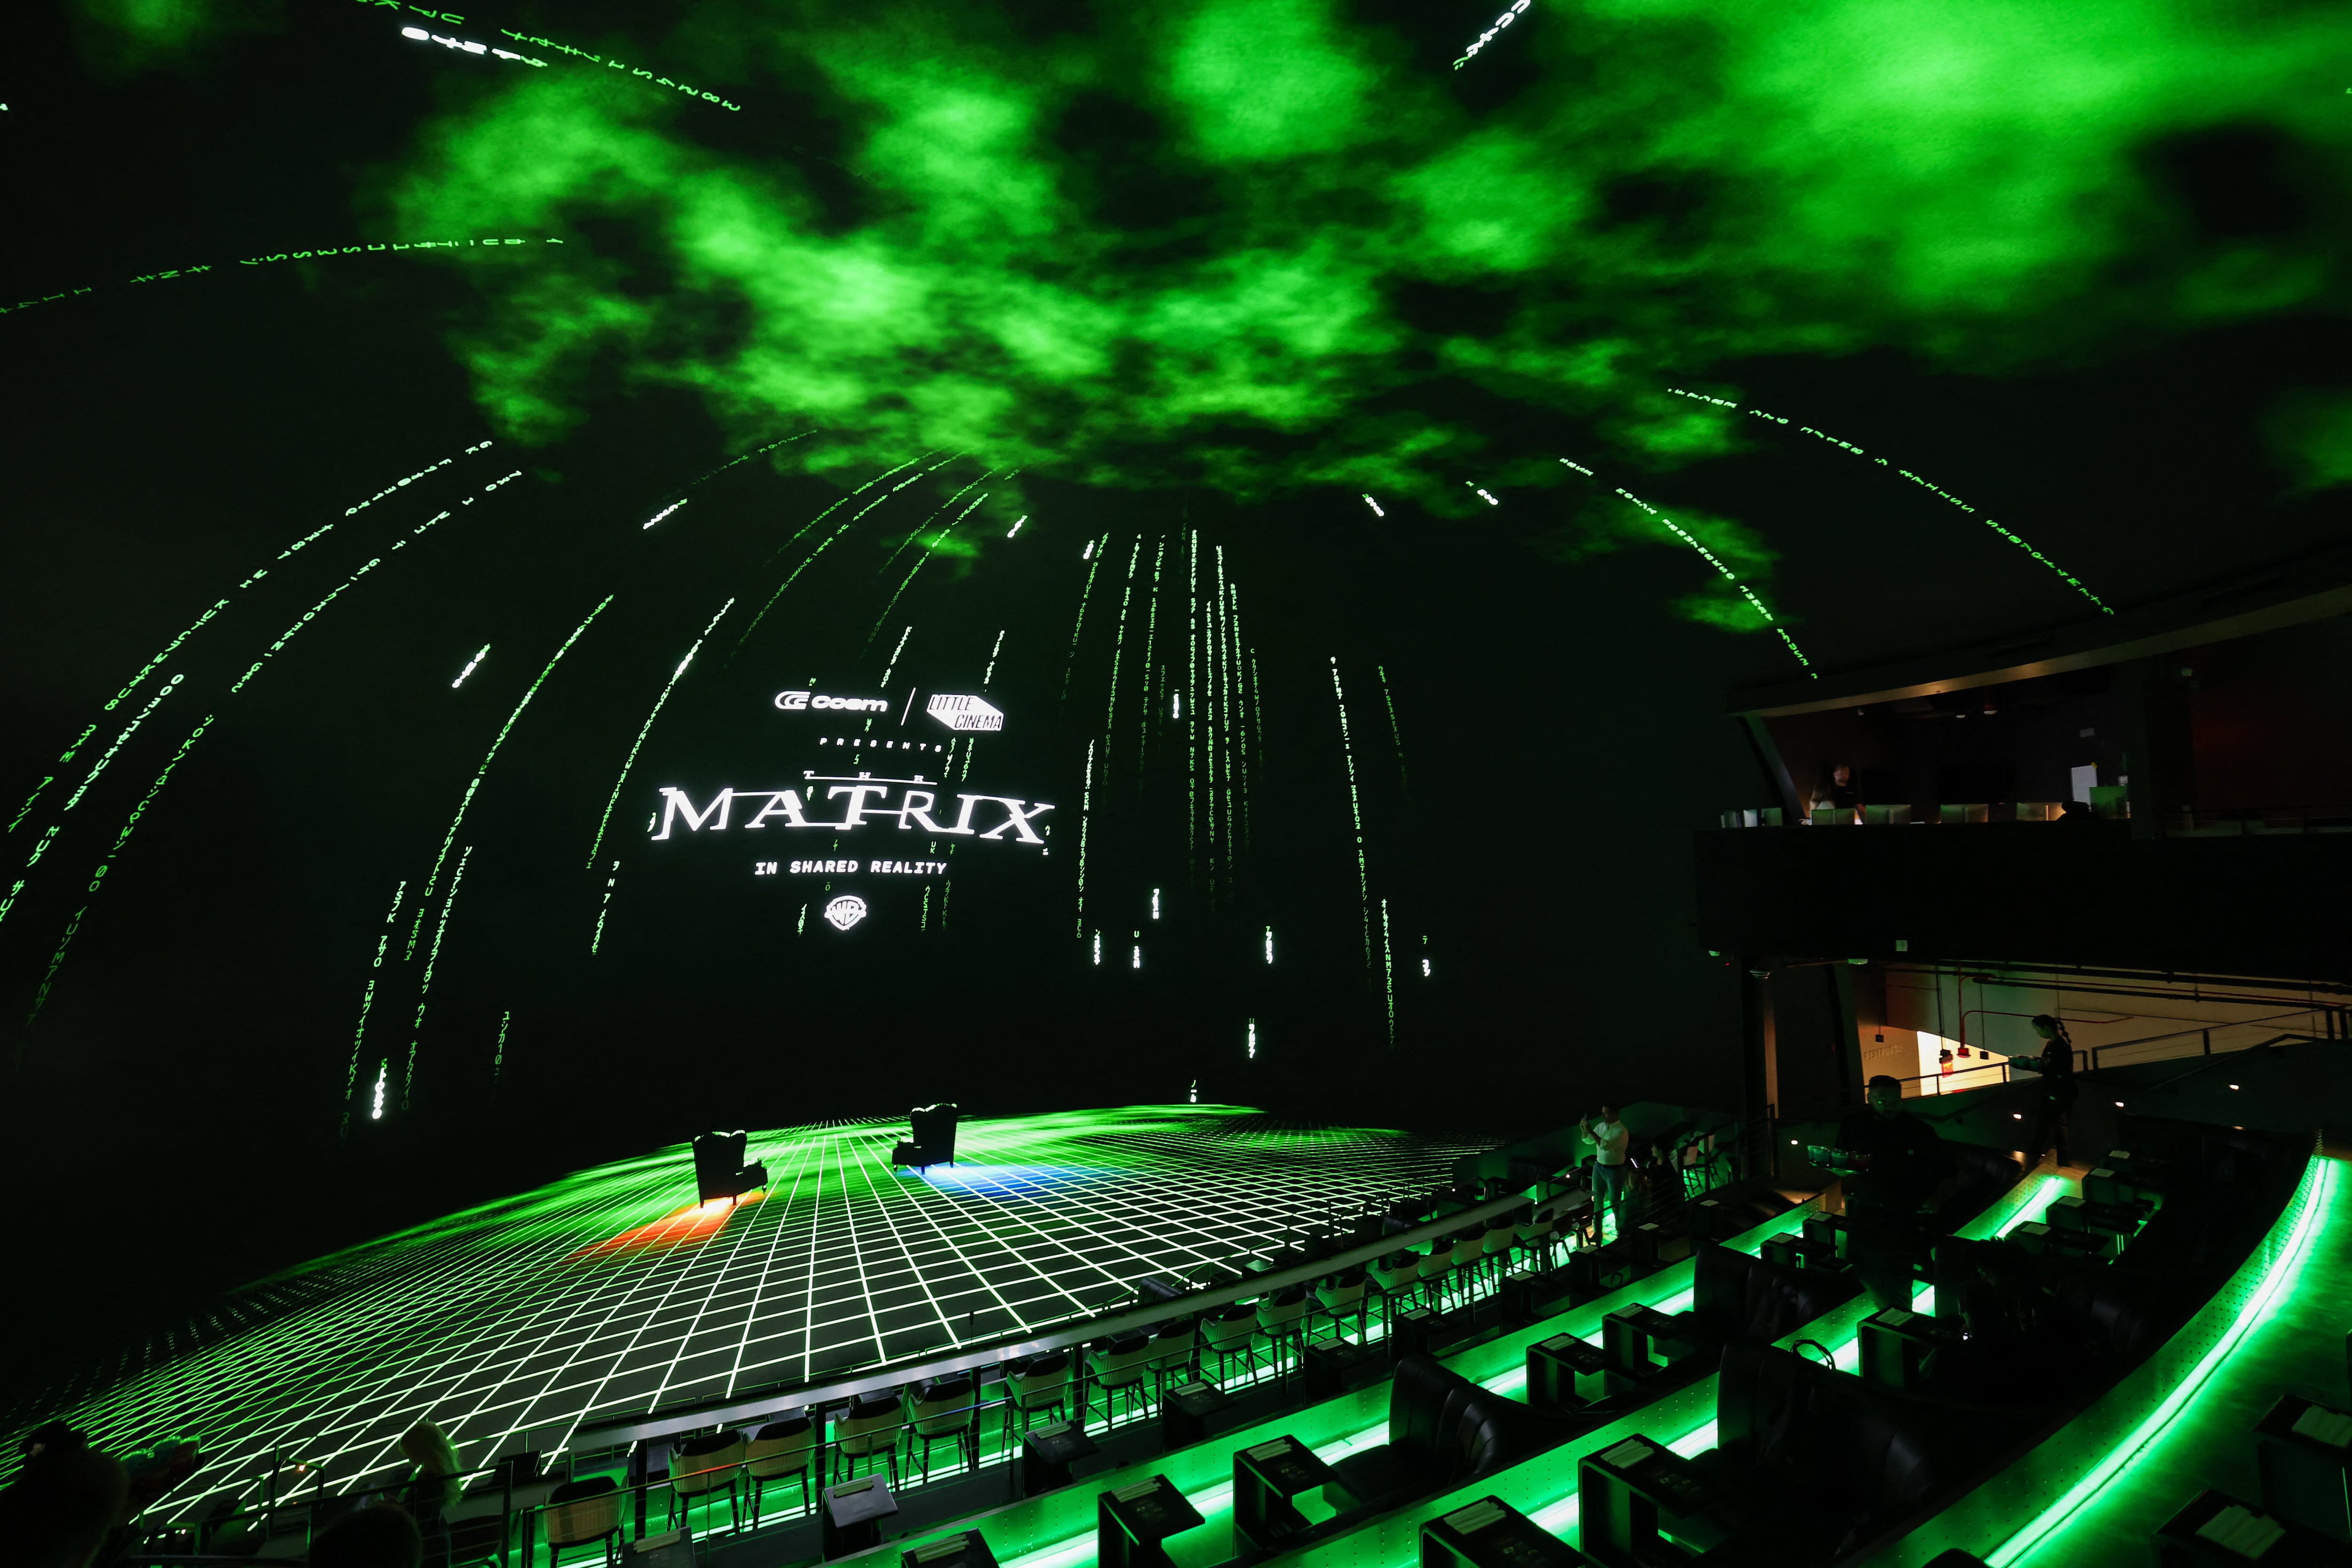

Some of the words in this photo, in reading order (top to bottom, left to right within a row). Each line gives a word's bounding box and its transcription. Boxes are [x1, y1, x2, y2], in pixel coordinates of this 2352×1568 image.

[929, 696, 975, 711] LITTLE
[954, 714, 1002, 729] CINEMA
[819, 737, 942, 753] PRESENTS
[651, 785, 1055, 844] MATRIX
[755, 861, 778, 876] IN
[789, 860, 858, 874] SHARED
[870, 861, 947, 875] REALITY
